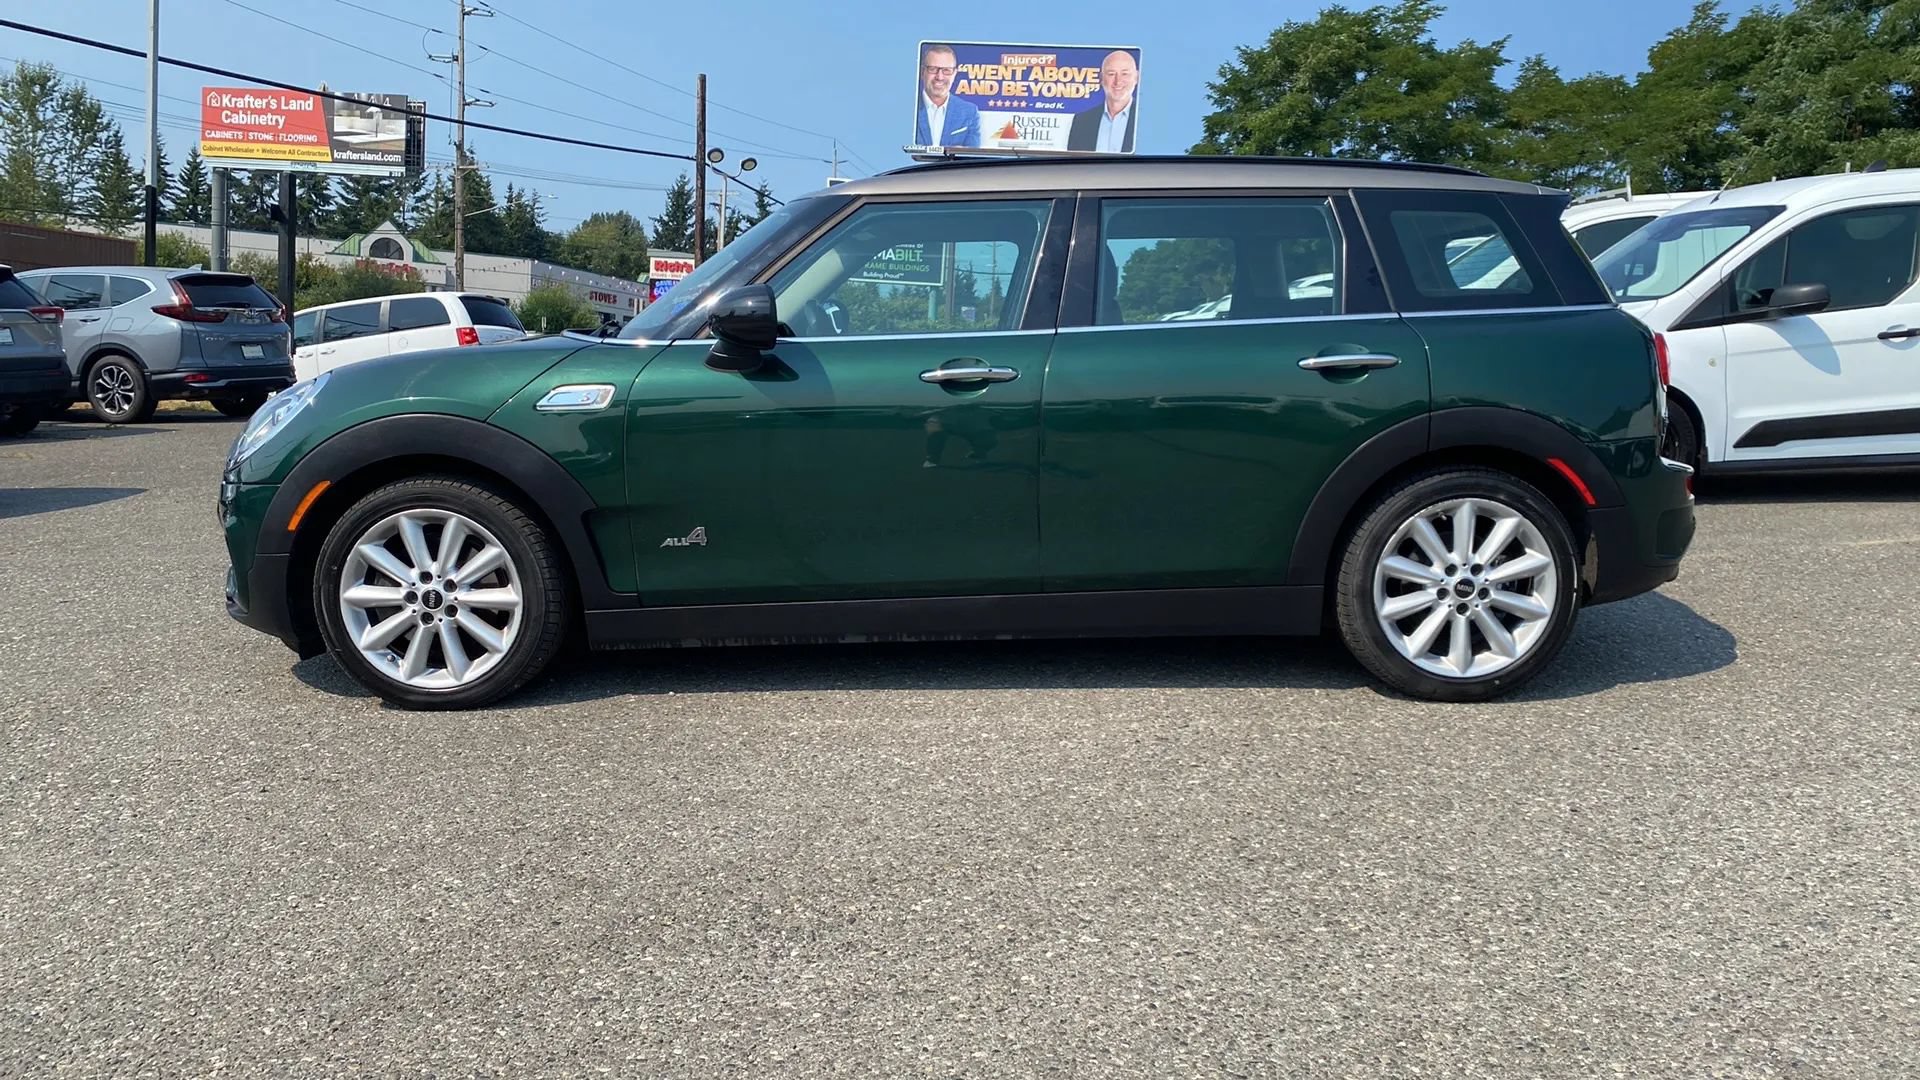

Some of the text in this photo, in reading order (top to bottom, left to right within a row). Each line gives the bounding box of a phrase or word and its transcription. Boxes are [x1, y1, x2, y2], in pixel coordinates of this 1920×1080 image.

[1003, 54, 1054, 65] Injured?
[1028, 66, 1100, 83] ABOVE
[955, 79, 999, 96] AND
[221, 94, 314, 111] Krafter's Land
[1034, 101, 1055, 109] Brad
[221, 110, 286, 129] Cabinetry
[1012, 114, 1060, 129] RUSSELL
[204, 129, 318, 143] CABINETS STONE FLOORING
[202, 144, 223, 152] Cabinet
[224, 145, 255, 154] Wholesaler
[261, 147, 287, 155] Welcome
[296, 149, 329, 157] Contractors
[333, 150, 402, 162] kraftersland.com
[654, 260, 694, 273] Rich's
[888, 262, 930, 273] BUILDINGS
[589, 290, 618, 305] STOVES
[1455, 583, 1474, 593] MINI
[428, 591, 437, 608] MINI
